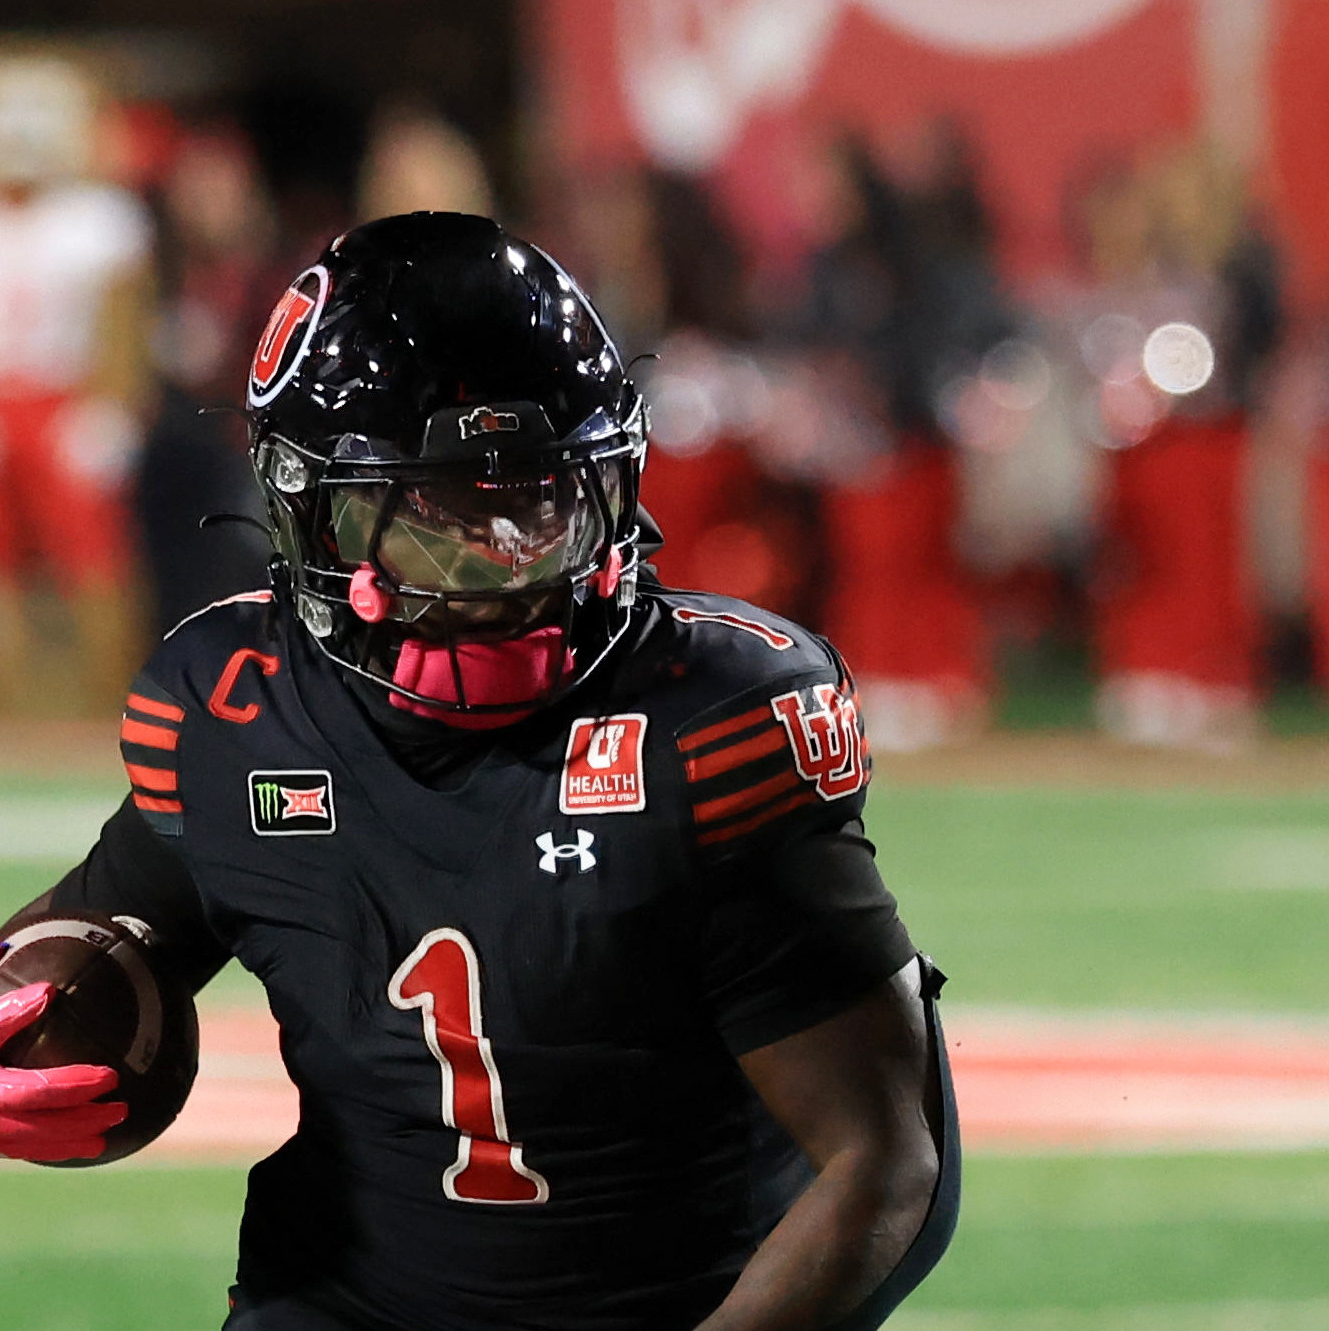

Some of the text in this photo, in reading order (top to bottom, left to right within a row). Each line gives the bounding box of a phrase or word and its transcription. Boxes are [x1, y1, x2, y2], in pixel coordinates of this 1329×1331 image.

[253, 287, 315, 388] U
[208, 647, 281, 724] C
[569, 773, 635, 794] HEALTH
[387, 927, 550, 1204] 1
